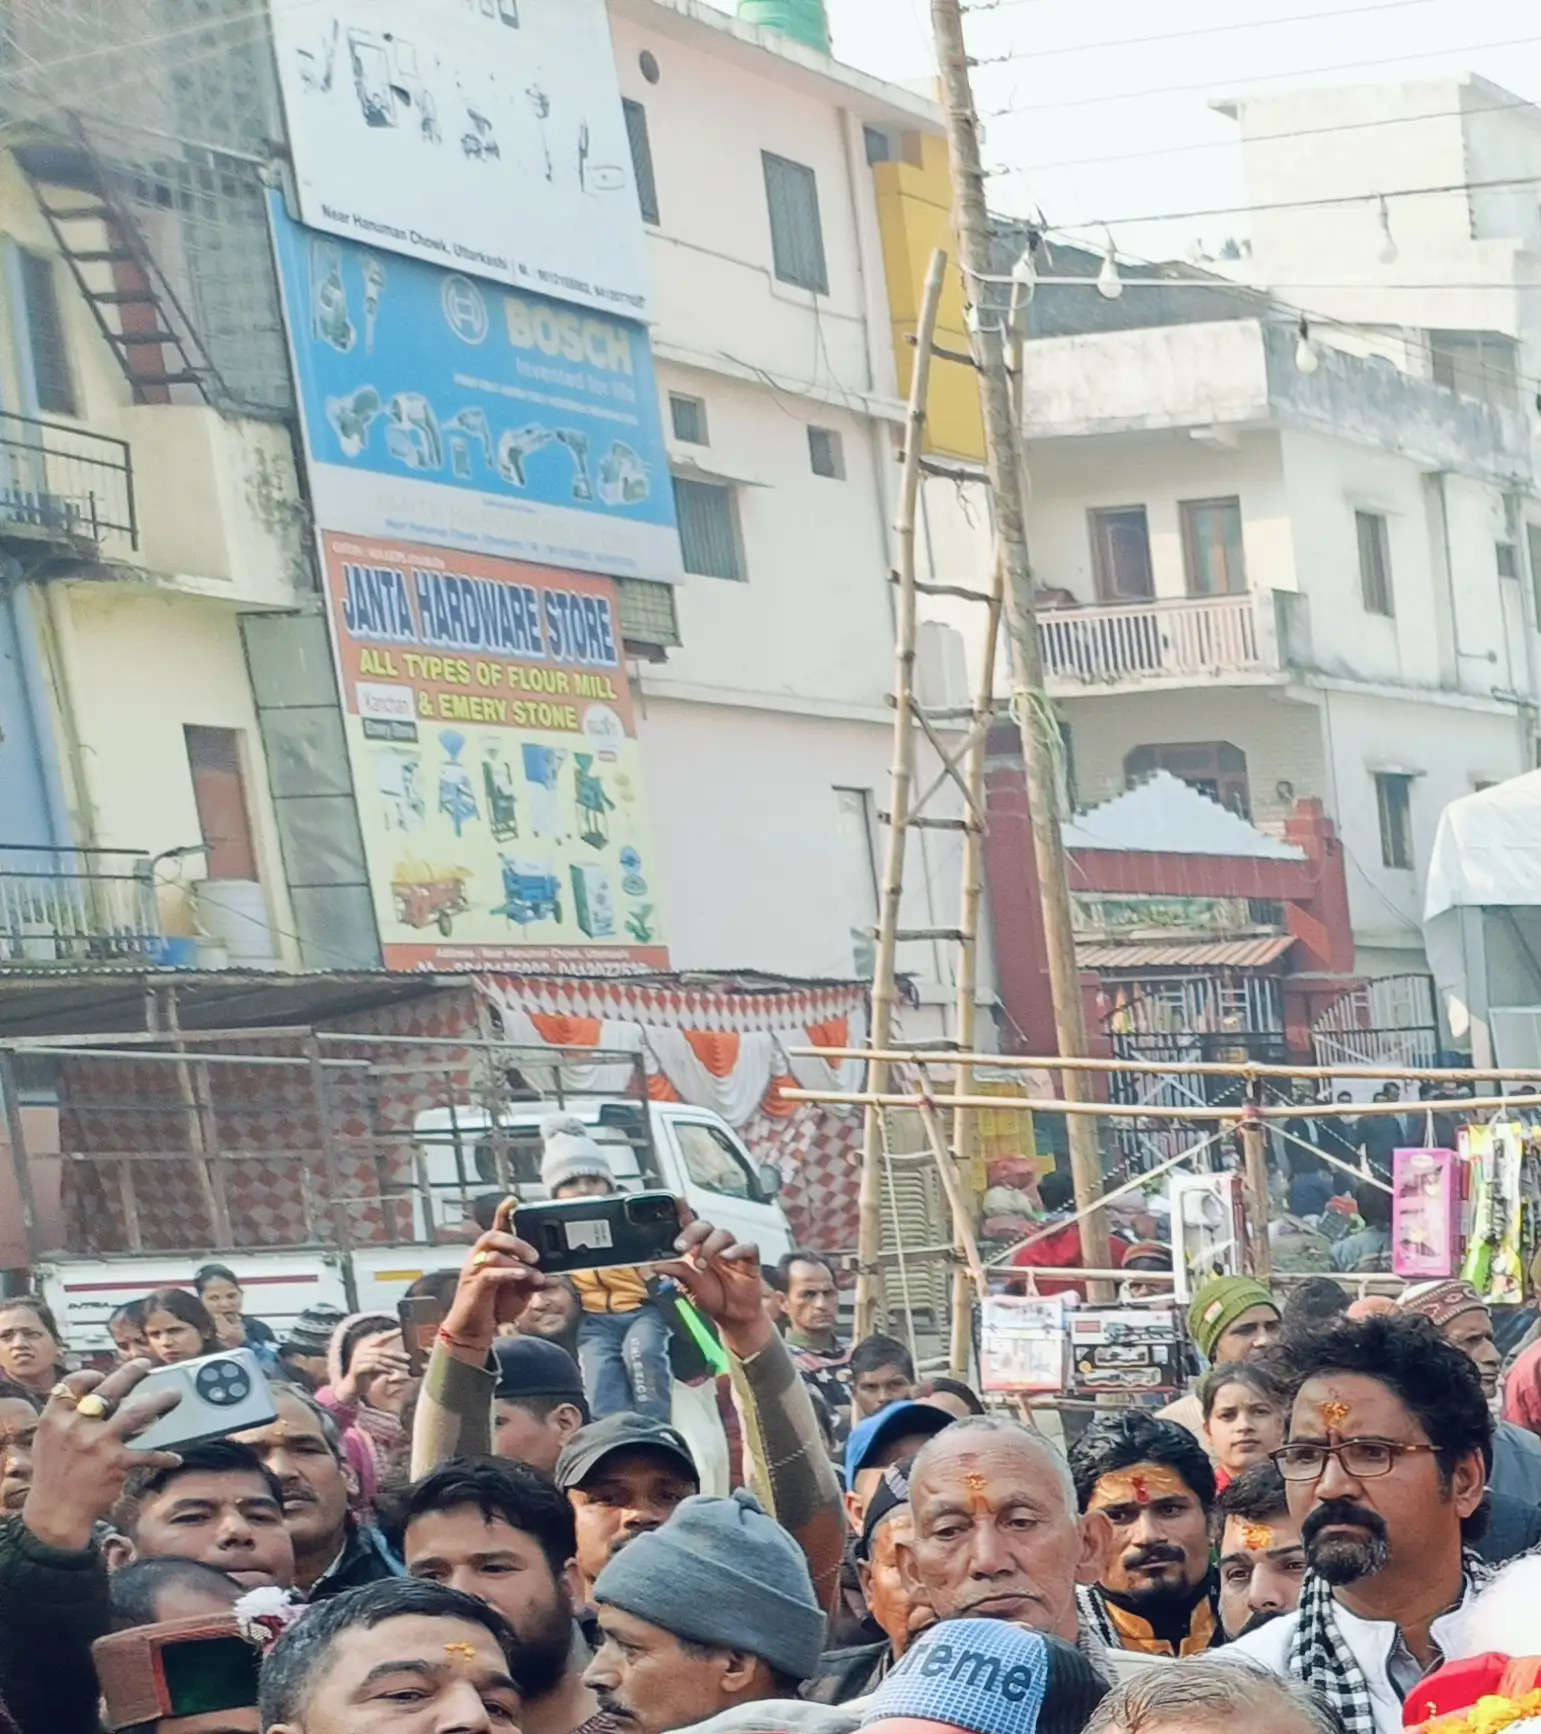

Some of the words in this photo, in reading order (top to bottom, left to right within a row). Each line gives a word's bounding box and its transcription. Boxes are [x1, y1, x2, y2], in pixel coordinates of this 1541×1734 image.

[505, 296, 633, 376] BOSCH
[341, 562, 417, 642] JANTA
[412, 568, 547, 660] HARDWARE
[543, 587, 618, 667] STORE
[360, 648, 399, 677] ALL
[402, 653, 472, 685] TYPES
[476, 662, 502, 687] OF
[507, 666, 571, 695] FLOUR
[574, 674, 618, 700] MILL
[418, 690, 434, 717] &
[438, 693, 508, 721] EMERY
[512, 702, 580, 730] STONE
